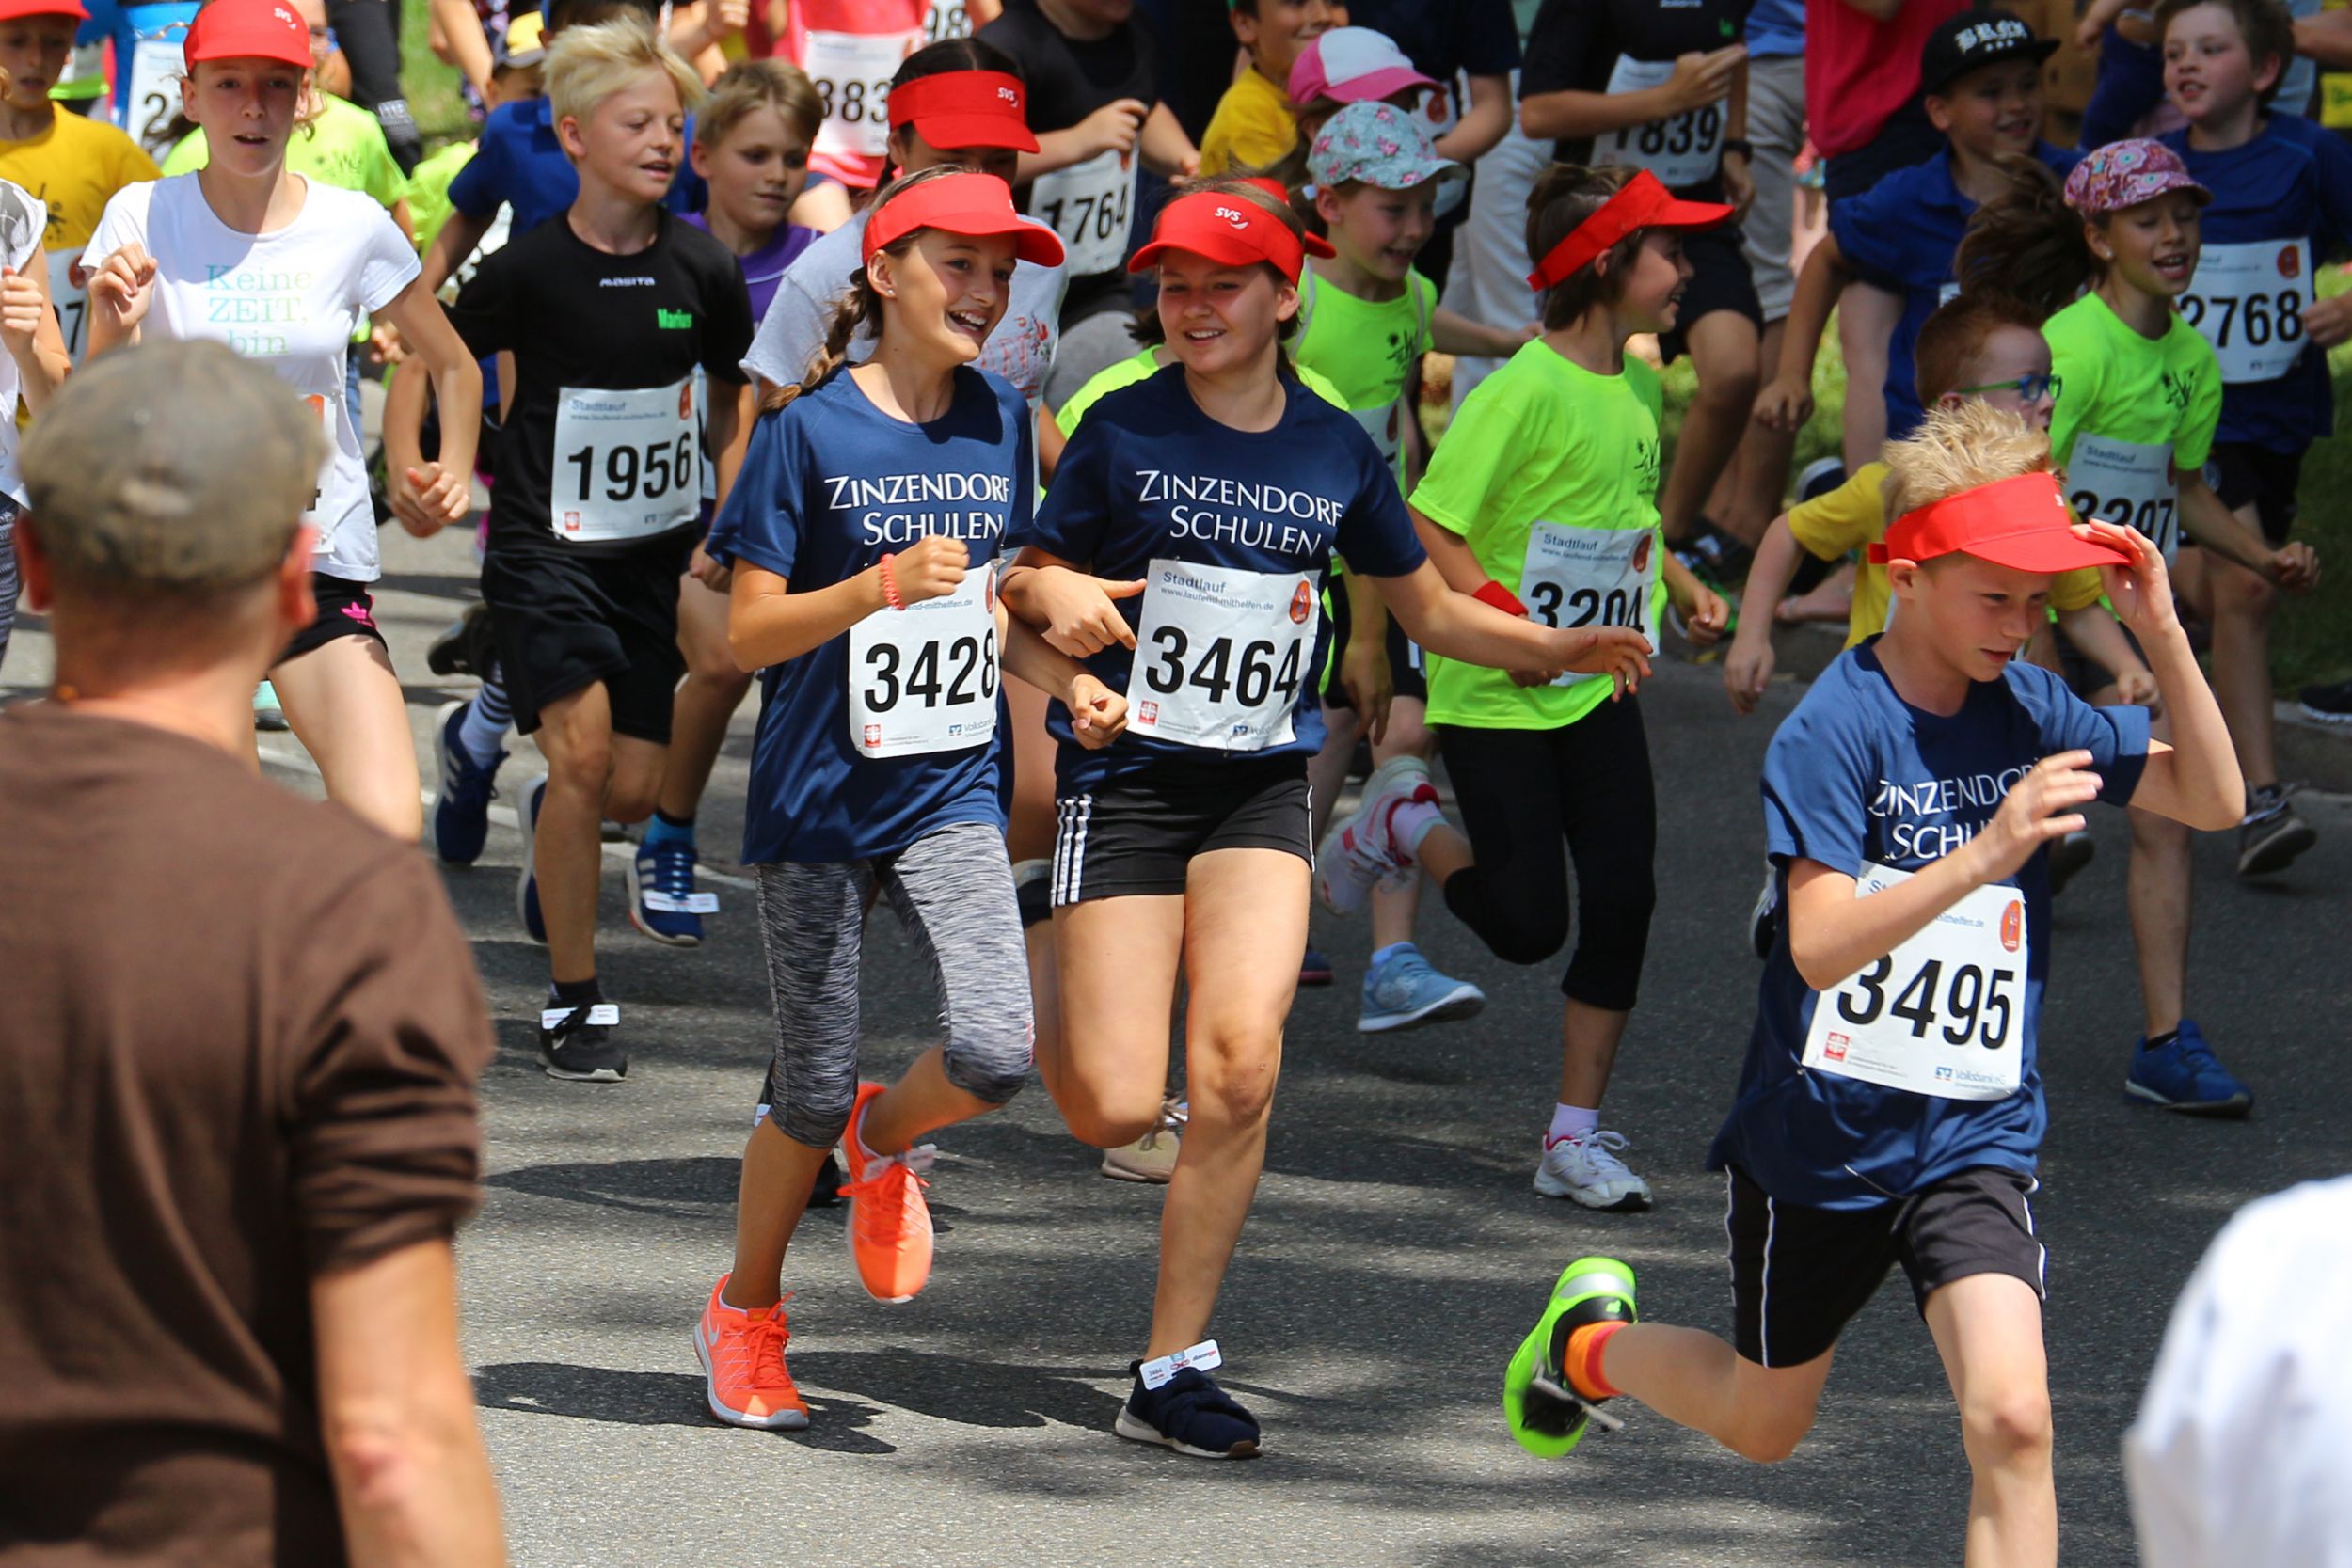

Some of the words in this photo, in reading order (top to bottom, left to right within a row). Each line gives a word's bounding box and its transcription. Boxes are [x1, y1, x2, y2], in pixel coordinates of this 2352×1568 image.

[1042, 184, 1127, 245] 1764
[1214, 206, 1242, 222] SVS
[204, 263, 311, 291] Keine
[227, 329, 288, 356] bin
[2180, 289, 2303, 348] 2768
[567, 430, 691, 501] 1956
[824, 472, 1010, 510] ZINZENDORF
[1136, 469, 1344, 528] ZINZENDORF
[863, 511, 1004, 546] SCHULEN
[1169, 504, 1322, 558] SCHULEN
[1543, 532, 1598, 551] Stadtlauf
[1163, 571, 1227, 594] Stadtlauf
[864, 627, 995, 713] 3428
[1145, 626, 1303, 707] 3464
[1836, 952, 2015, 1051] 3495
